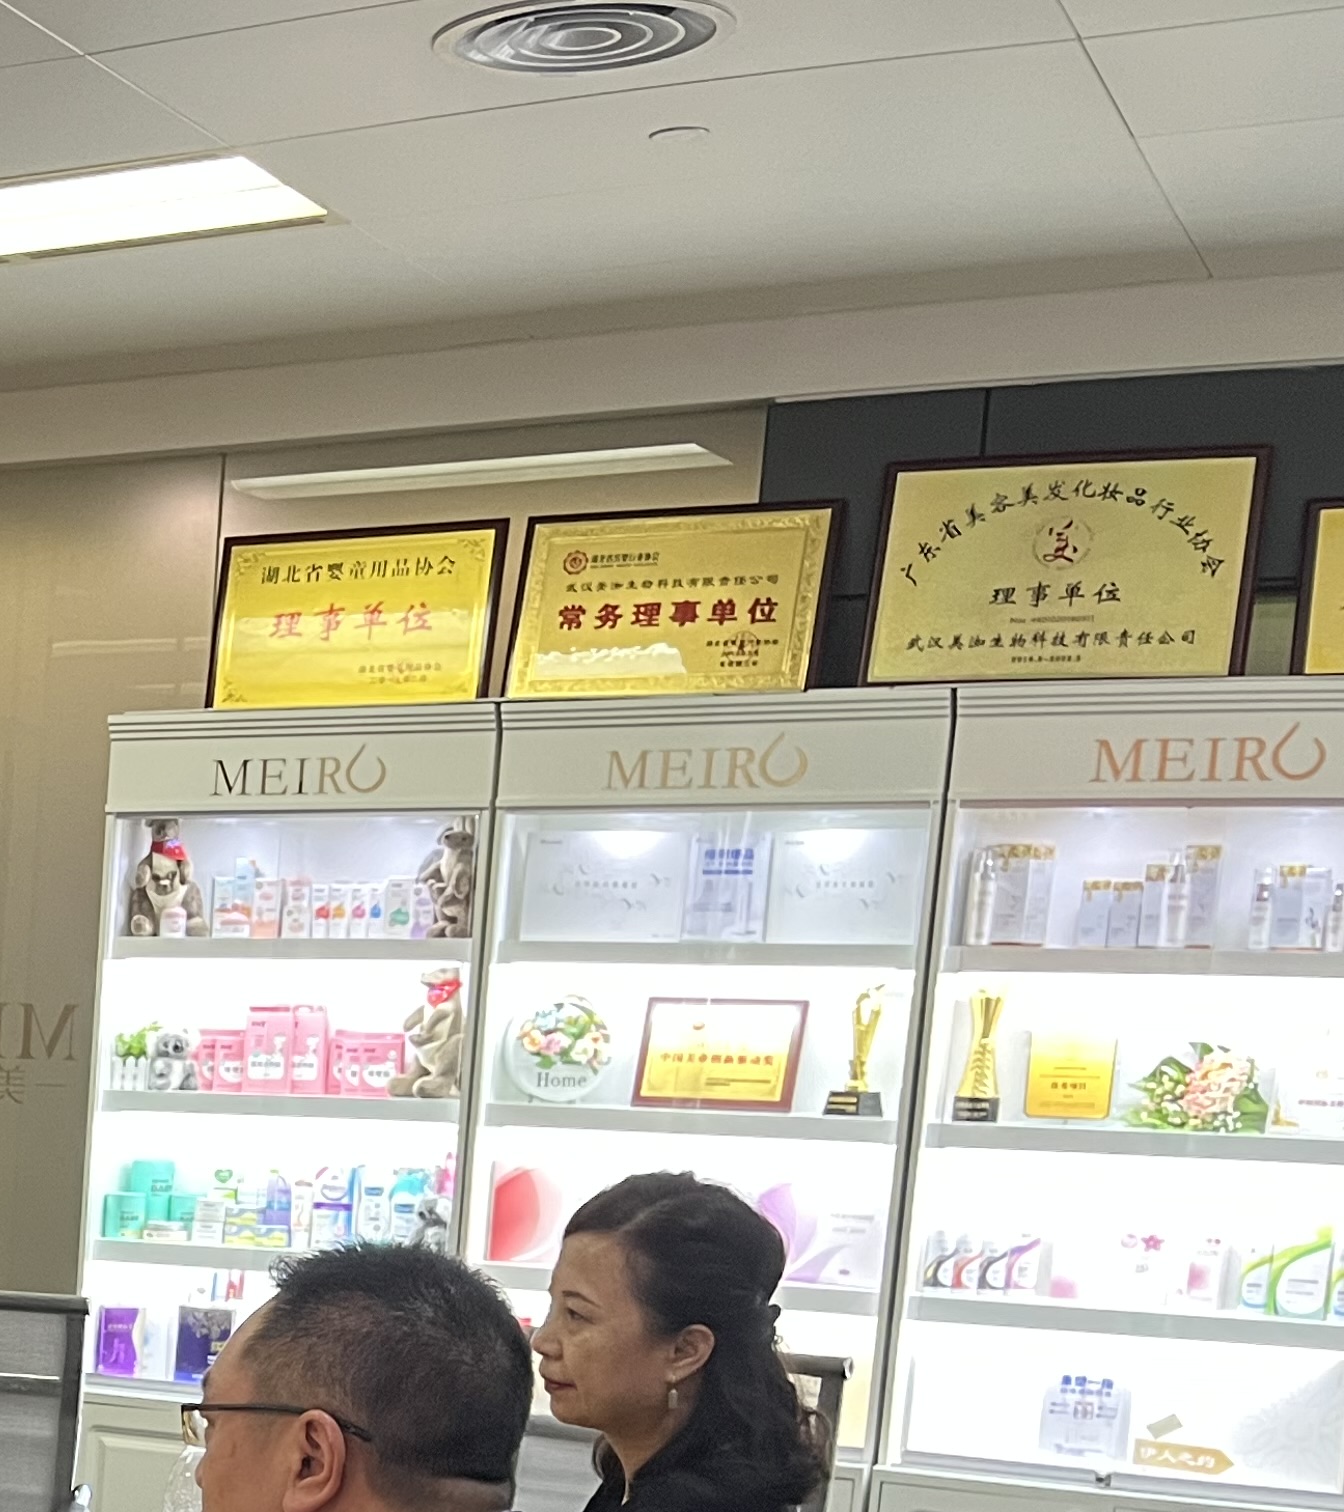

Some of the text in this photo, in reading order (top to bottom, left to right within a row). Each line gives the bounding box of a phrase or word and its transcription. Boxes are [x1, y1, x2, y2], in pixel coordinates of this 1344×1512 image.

[261, 555, 456, 585] 湖北省婴童用品协会
[989, 581, 1122, 608] 理事单位
[268, 600, 433, 642] 理事单位
[558, 597, 779, 631] 常务理事单位
[537, 1072, 587, 1088] Home
